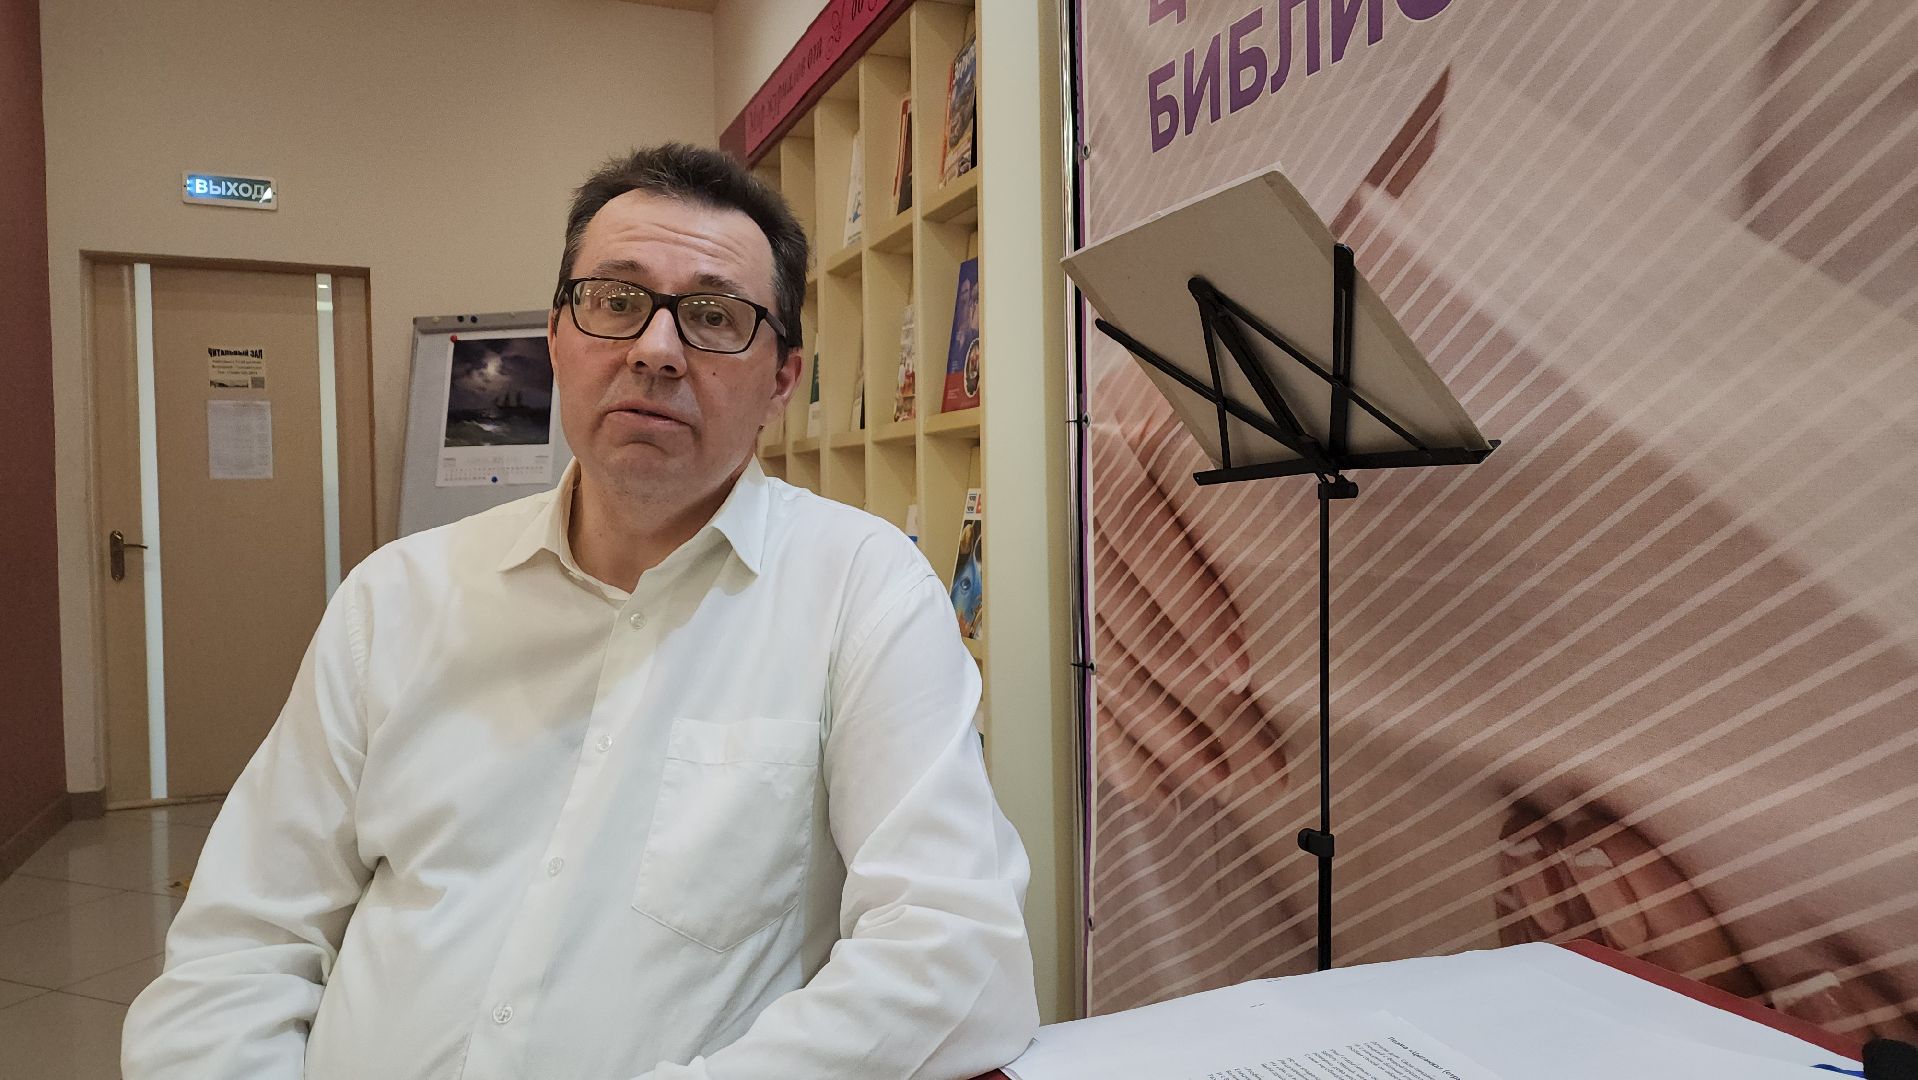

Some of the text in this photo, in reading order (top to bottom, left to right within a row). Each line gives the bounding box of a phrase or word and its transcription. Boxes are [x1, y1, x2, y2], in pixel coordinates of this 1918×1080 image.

[1148, 0, 1453, 154] БИБЛИ
[195, 178, 266, 200] ВЫХОД
[249, 349, 263, 359] ЗАЛ
